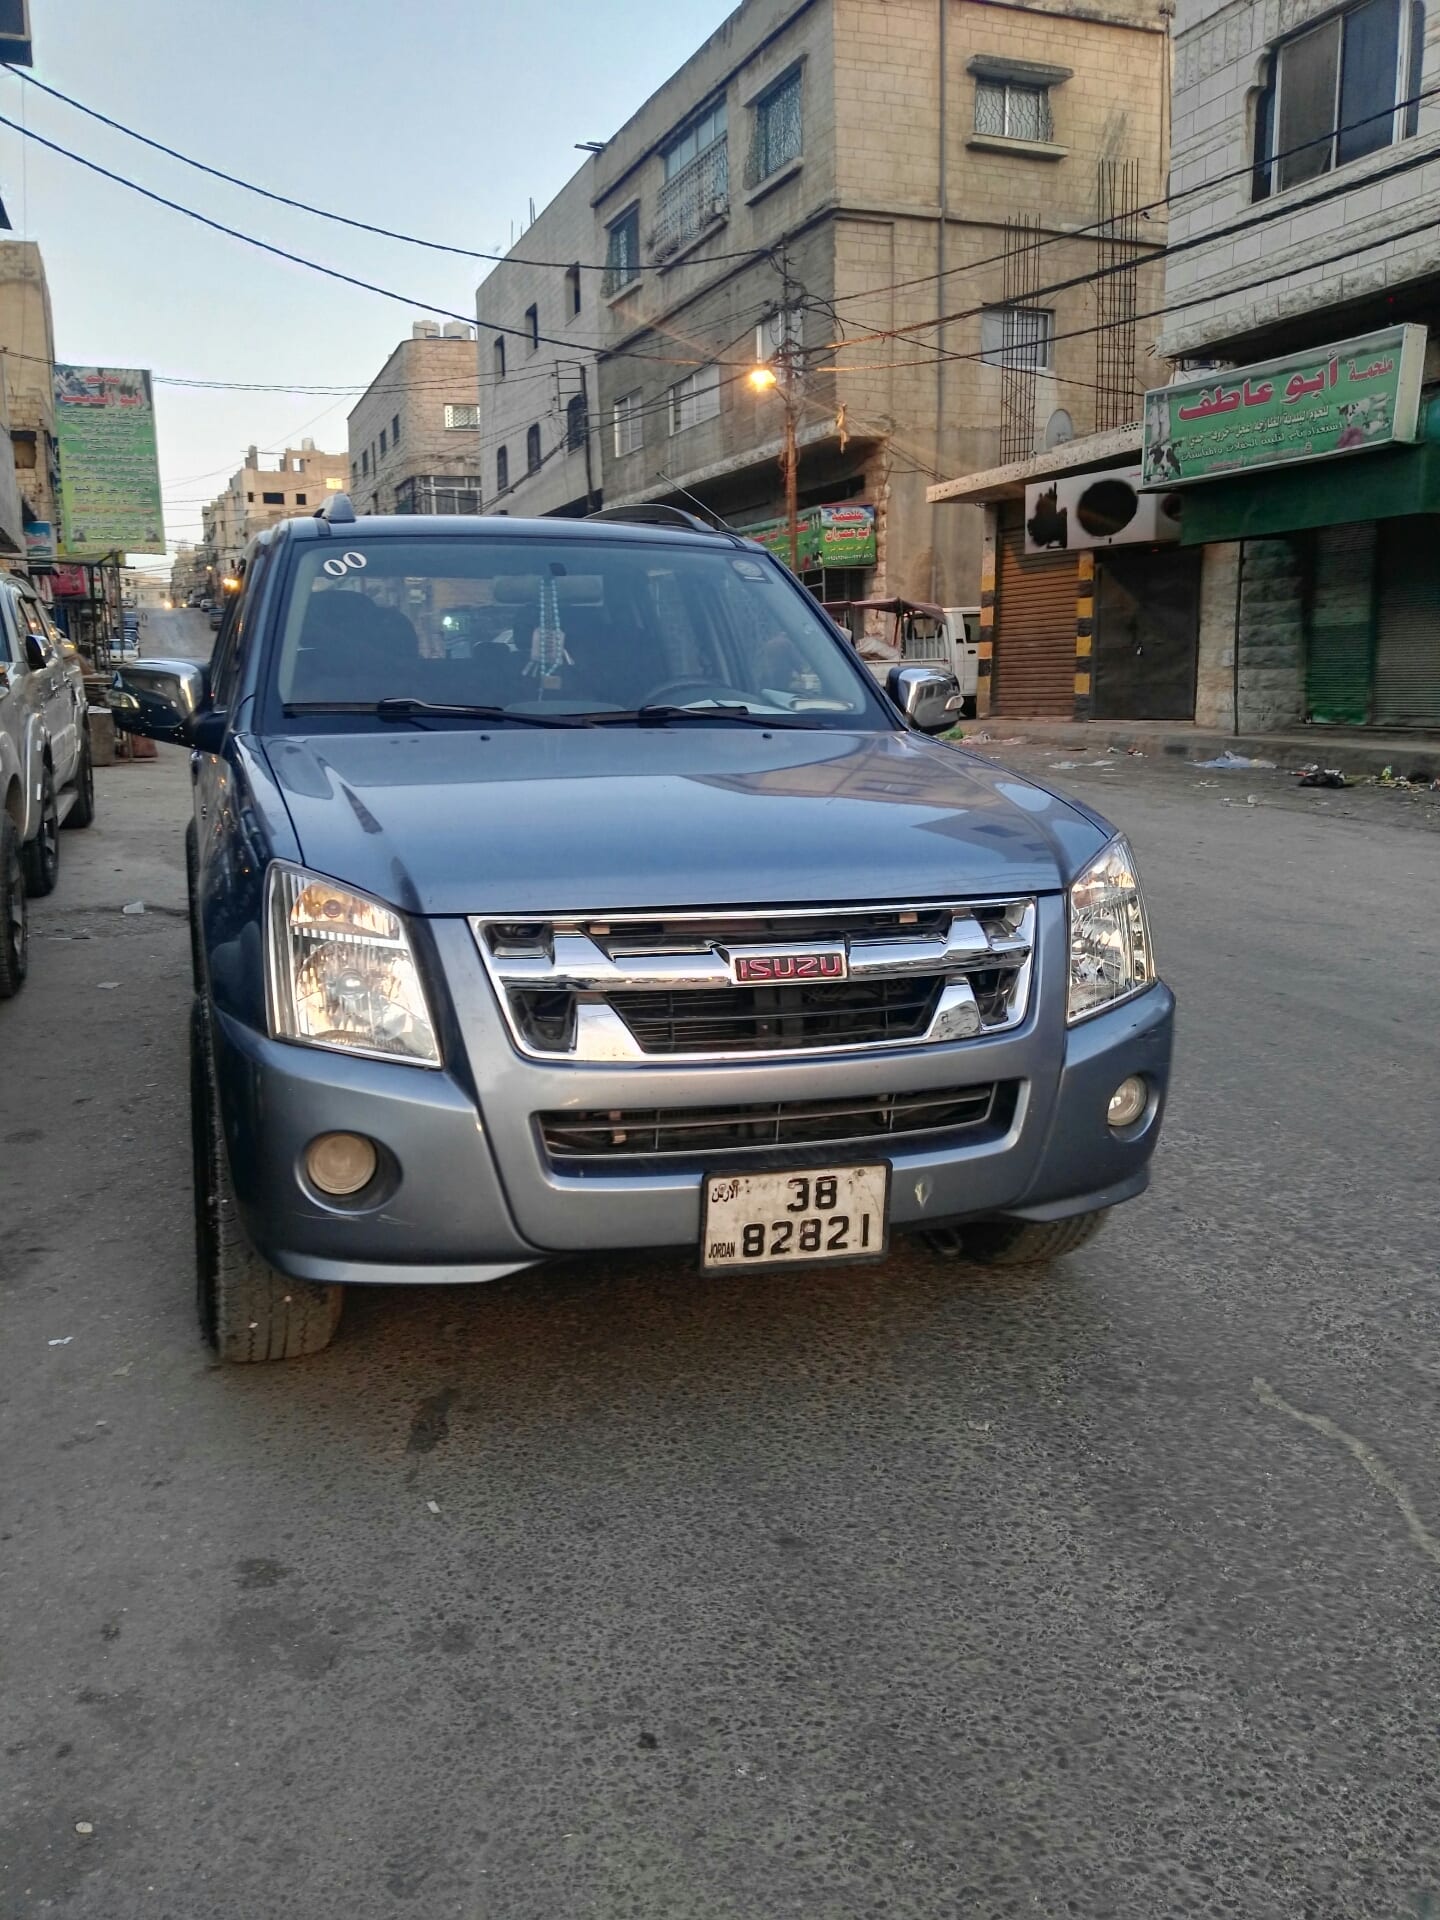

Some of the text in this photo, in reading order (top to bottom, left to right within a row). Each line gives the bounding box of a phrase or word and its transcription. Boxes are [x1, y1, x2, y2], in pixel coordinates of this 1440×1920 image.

[1177, 350, 1394, 422] ملحمة أبو عاطف
[739, 955, 840, 979] ISUZU
[787, 1175, 838, 1213] 38
[708, 1241, 735, 1258] JORDAN
[742, 1213, 870, 1258] 82821
